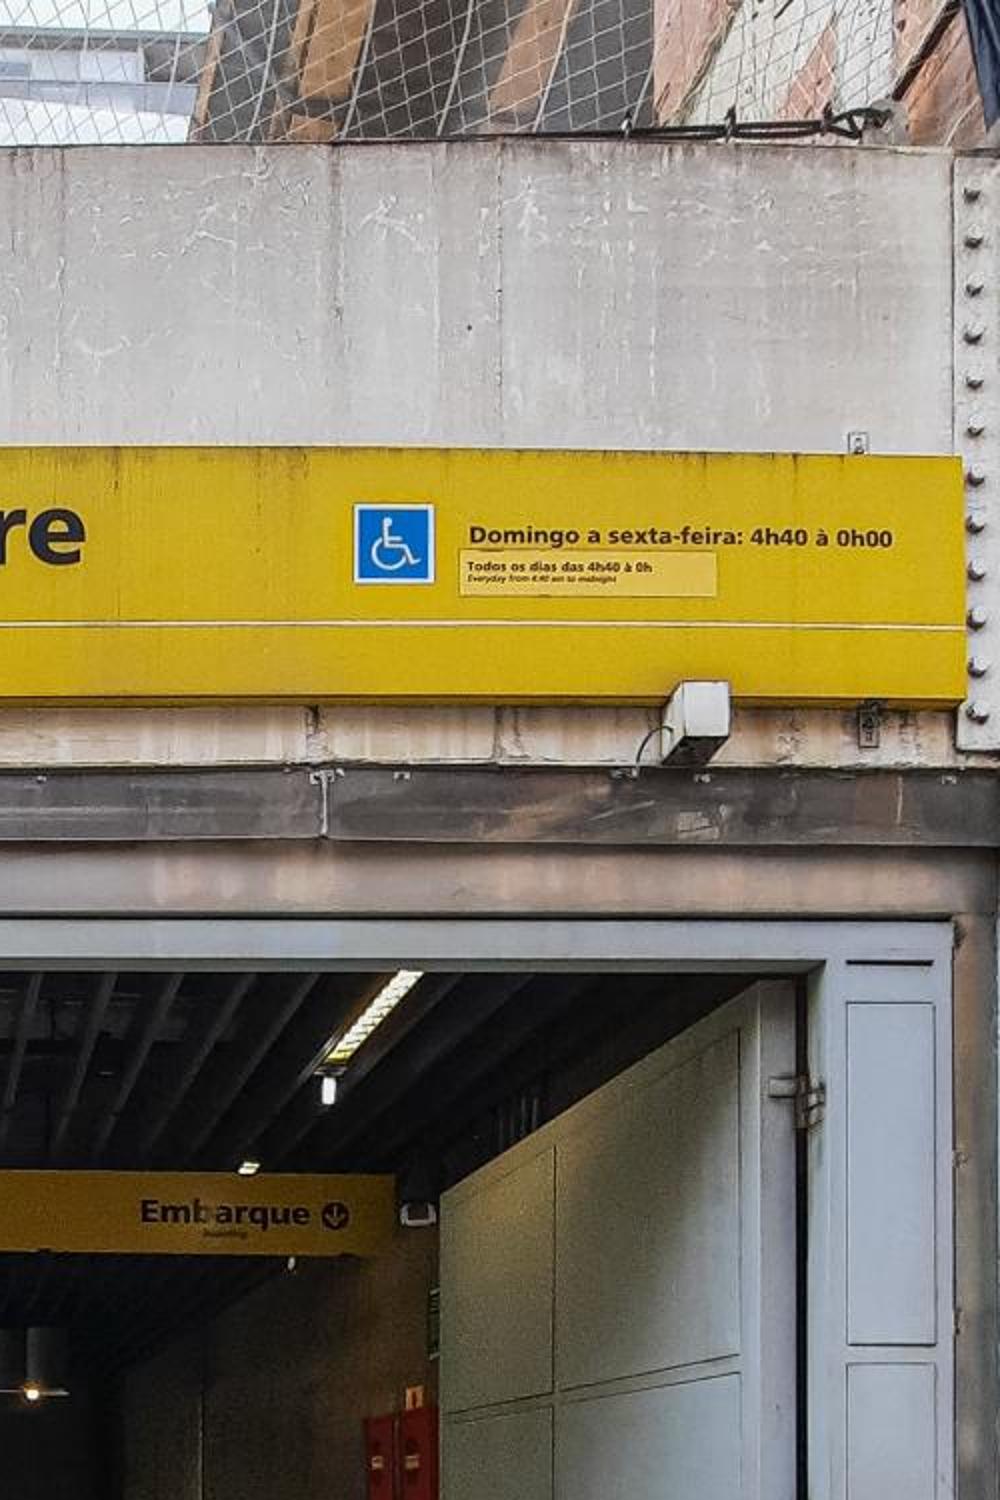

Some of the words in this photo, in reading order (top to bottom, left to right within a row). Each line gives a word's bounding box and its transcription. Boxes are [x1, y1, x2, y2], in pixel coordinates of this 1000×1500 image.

[469, 526, 580, 548] Domingo
[587, 531, 601, 544] a
[607, 526, 743, 545] sexta-feira:
[750, 528, 807, 546] 4h40
[815, 528, 829, 547] à
[836, 530, 893, 548] 0h00
[467, 561, 507, 572] Todos
[511, 563, 525, 572] os
[529, 561, 557, 572] dias
[561, 561, 584, 572] das
[587, 562, 620, 573] 4h40
[140, 1198, 311, 1231] Embarque
